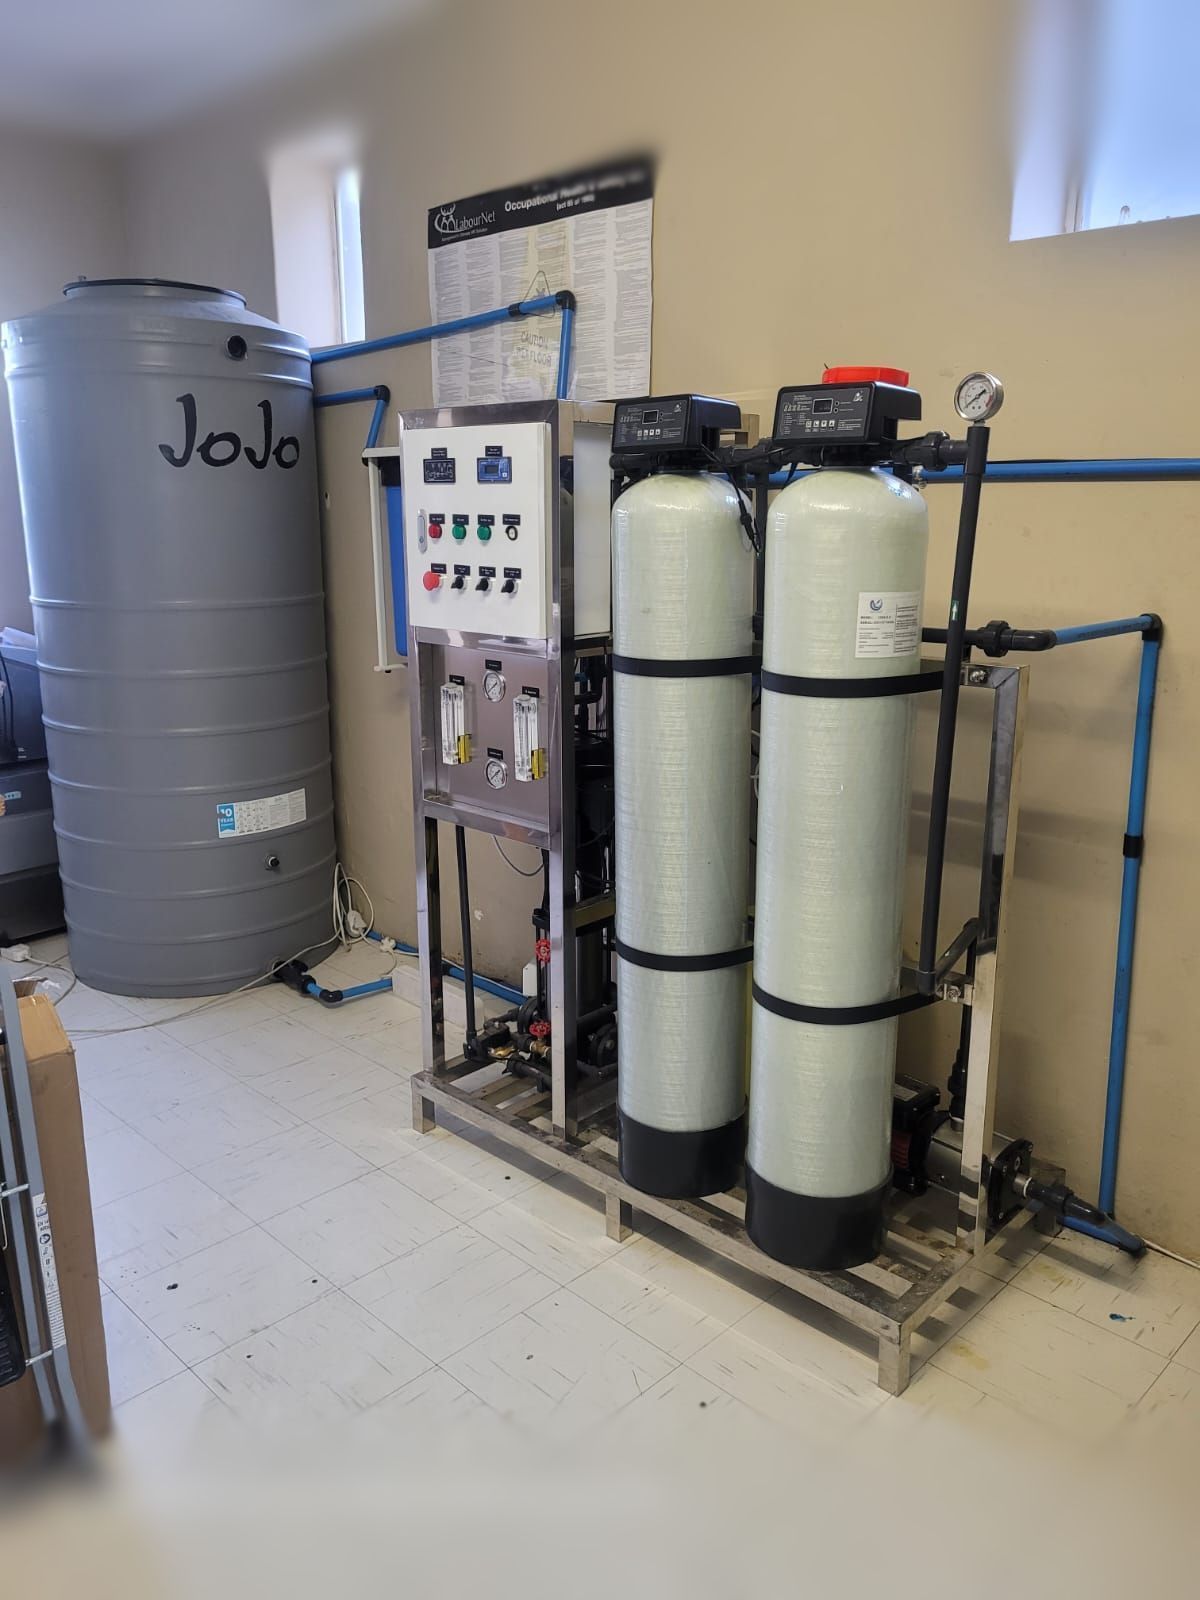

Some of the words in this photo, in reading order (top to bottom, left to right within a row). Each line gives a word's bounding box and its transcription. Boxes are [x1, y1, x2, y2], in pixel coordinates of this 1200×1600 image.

[504, 191, 558, 212] Occupational
[455, 210, 496, 231] LabourNet
[158, 393, 300, 469] JoJo
